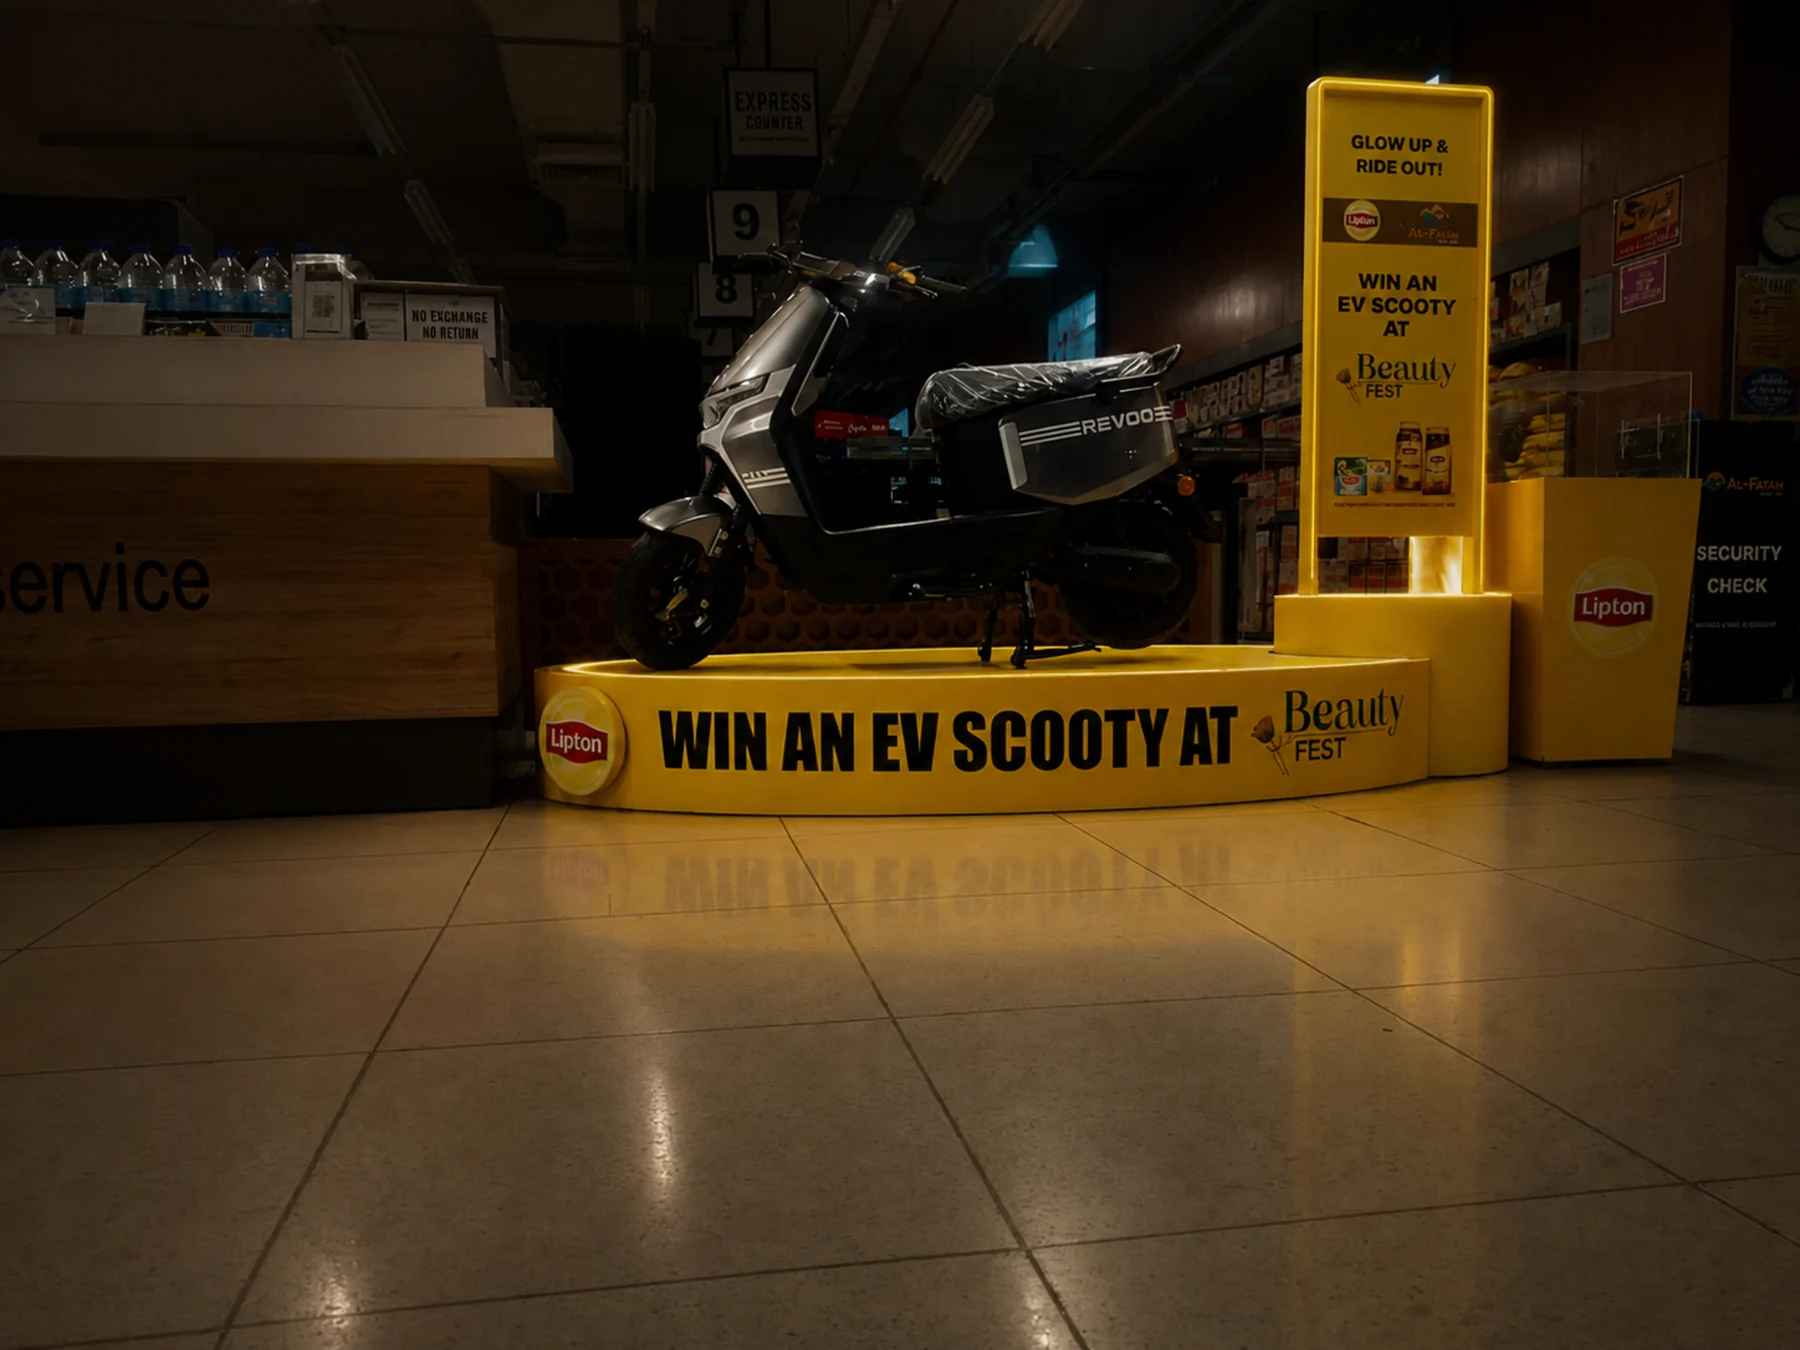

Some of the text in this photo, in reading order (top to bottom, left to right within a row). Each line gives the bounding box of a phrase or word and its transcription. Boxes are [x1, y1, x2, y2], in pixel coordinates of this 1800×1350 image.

[735, 91, 811, 112] EXPRESS
[746, 115, 803, 130] COUNTER
[1351, 134, 1449, 153] GLOW UP &
[1356, 159, 1443, 176] RIDE OUT!
[732, 203, 759, 240] 9
[715, 275, 738, 304] 8
[1358, 273, 1437, 291] WIN AN
[1338, 296, 1456, 315] EV SCOOTY
[412, 309, 488, 324] NO EXCHANGE
[423, 326, 479, 340] NO RETURN
[1383, 321, 1410, 337] AT
[1357, 353, 1457, 388] Beauty
[1365, 384, 1403, 398] FEST
[1697, 545, 1783, 562] SECURITY
[0, 542, 210, 613] ervice
[1707, 577, 1768, 594] CHECK
[1582, 597, 1646, 620] Lipton
[1284, 687, 1404, 737] Beauty
[550, 727, 602, 754] Lipton
[658, 705, 1238, 773] WIN AN EV SCOOTY AT
[1294, 737, 1347, 762] FEST
